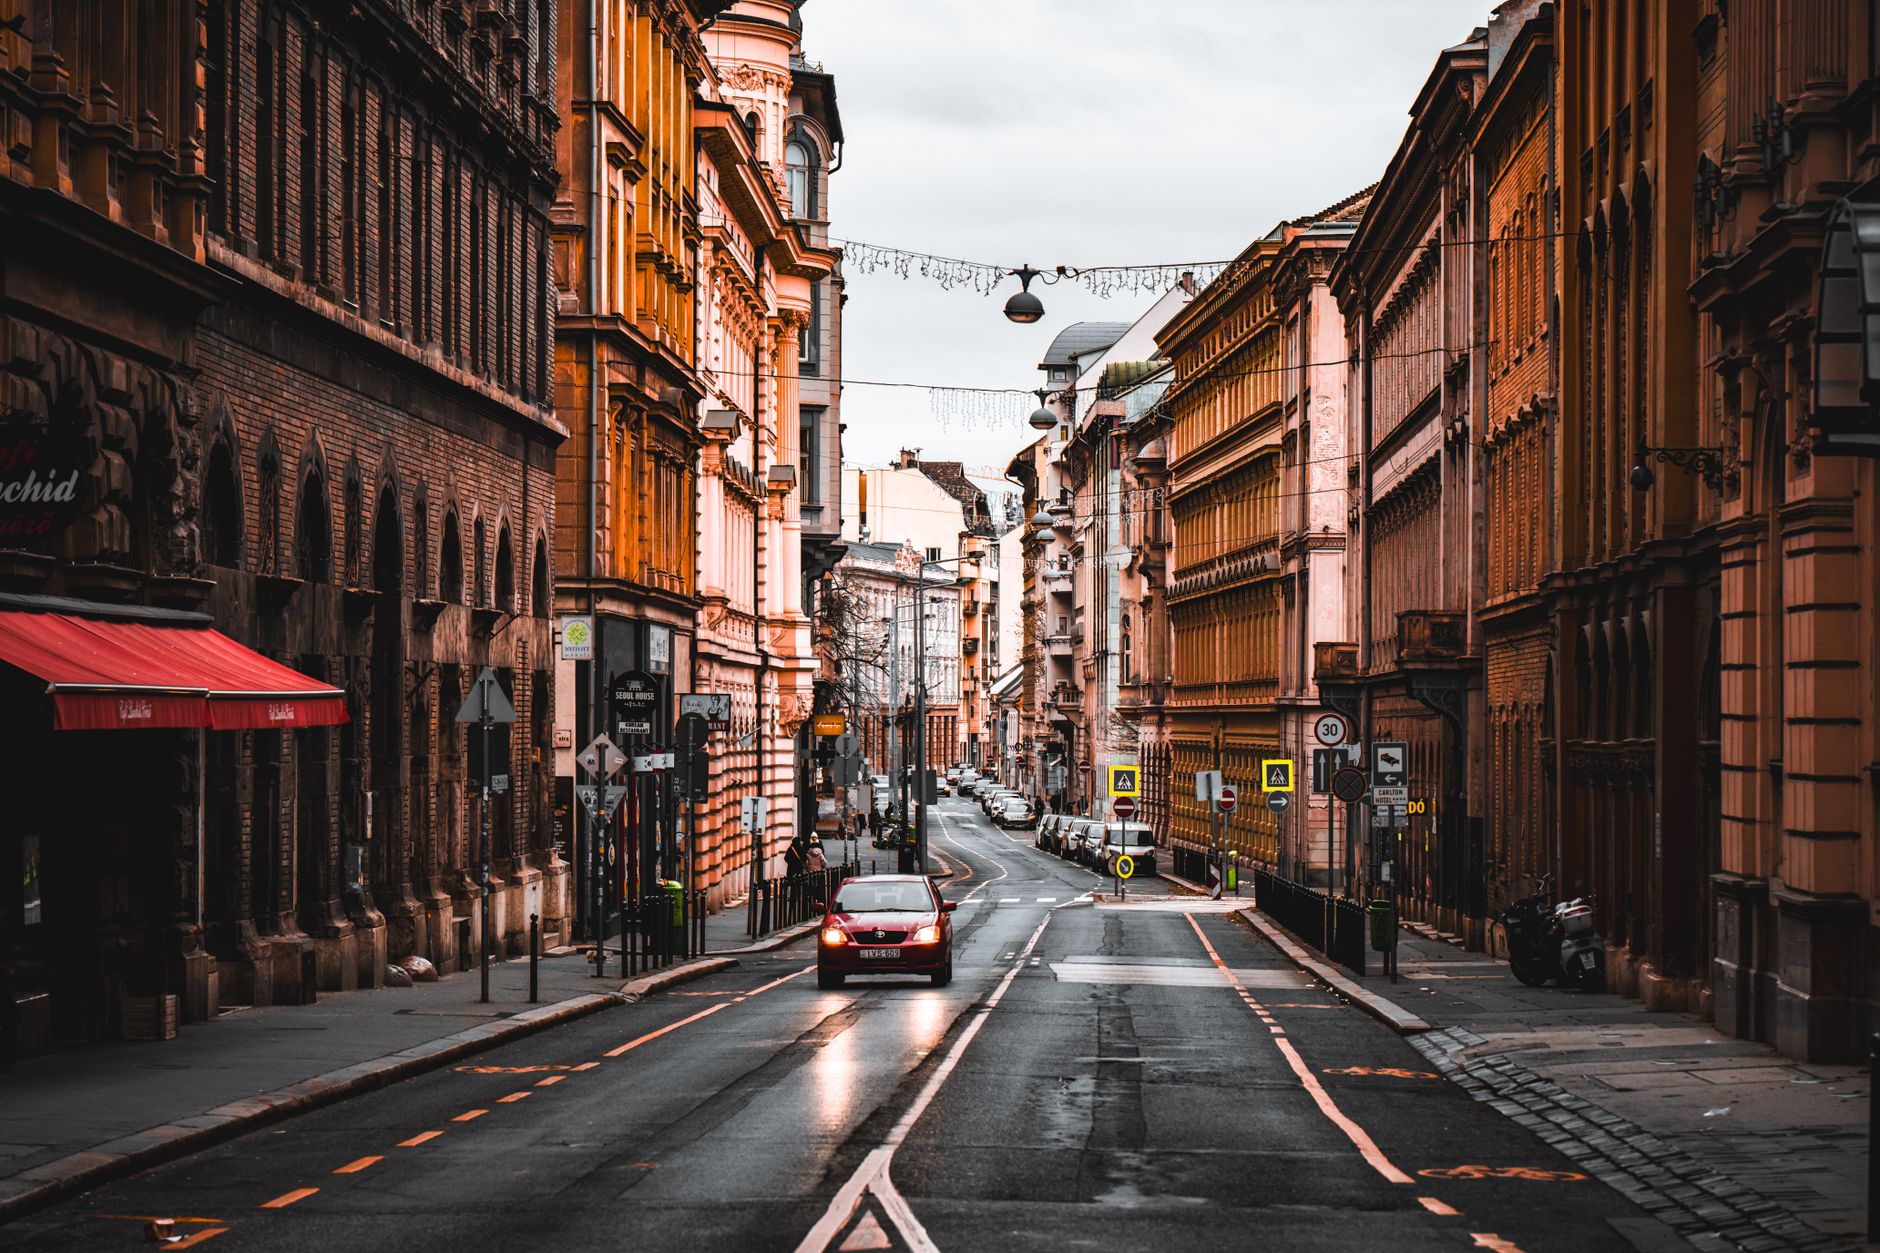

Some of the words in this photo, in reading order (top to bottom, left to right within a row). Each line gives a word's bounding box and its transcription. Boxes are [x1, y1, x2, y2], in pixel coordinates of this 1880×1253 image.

[0, 468, 79, 503] chid
[615, 691, 634, 700] SEOUL
[635, 692, 655, 701] HOUSE
[1322, 723, 1338, 736] 30
[1405, 798, 1426, 814] DÓ
